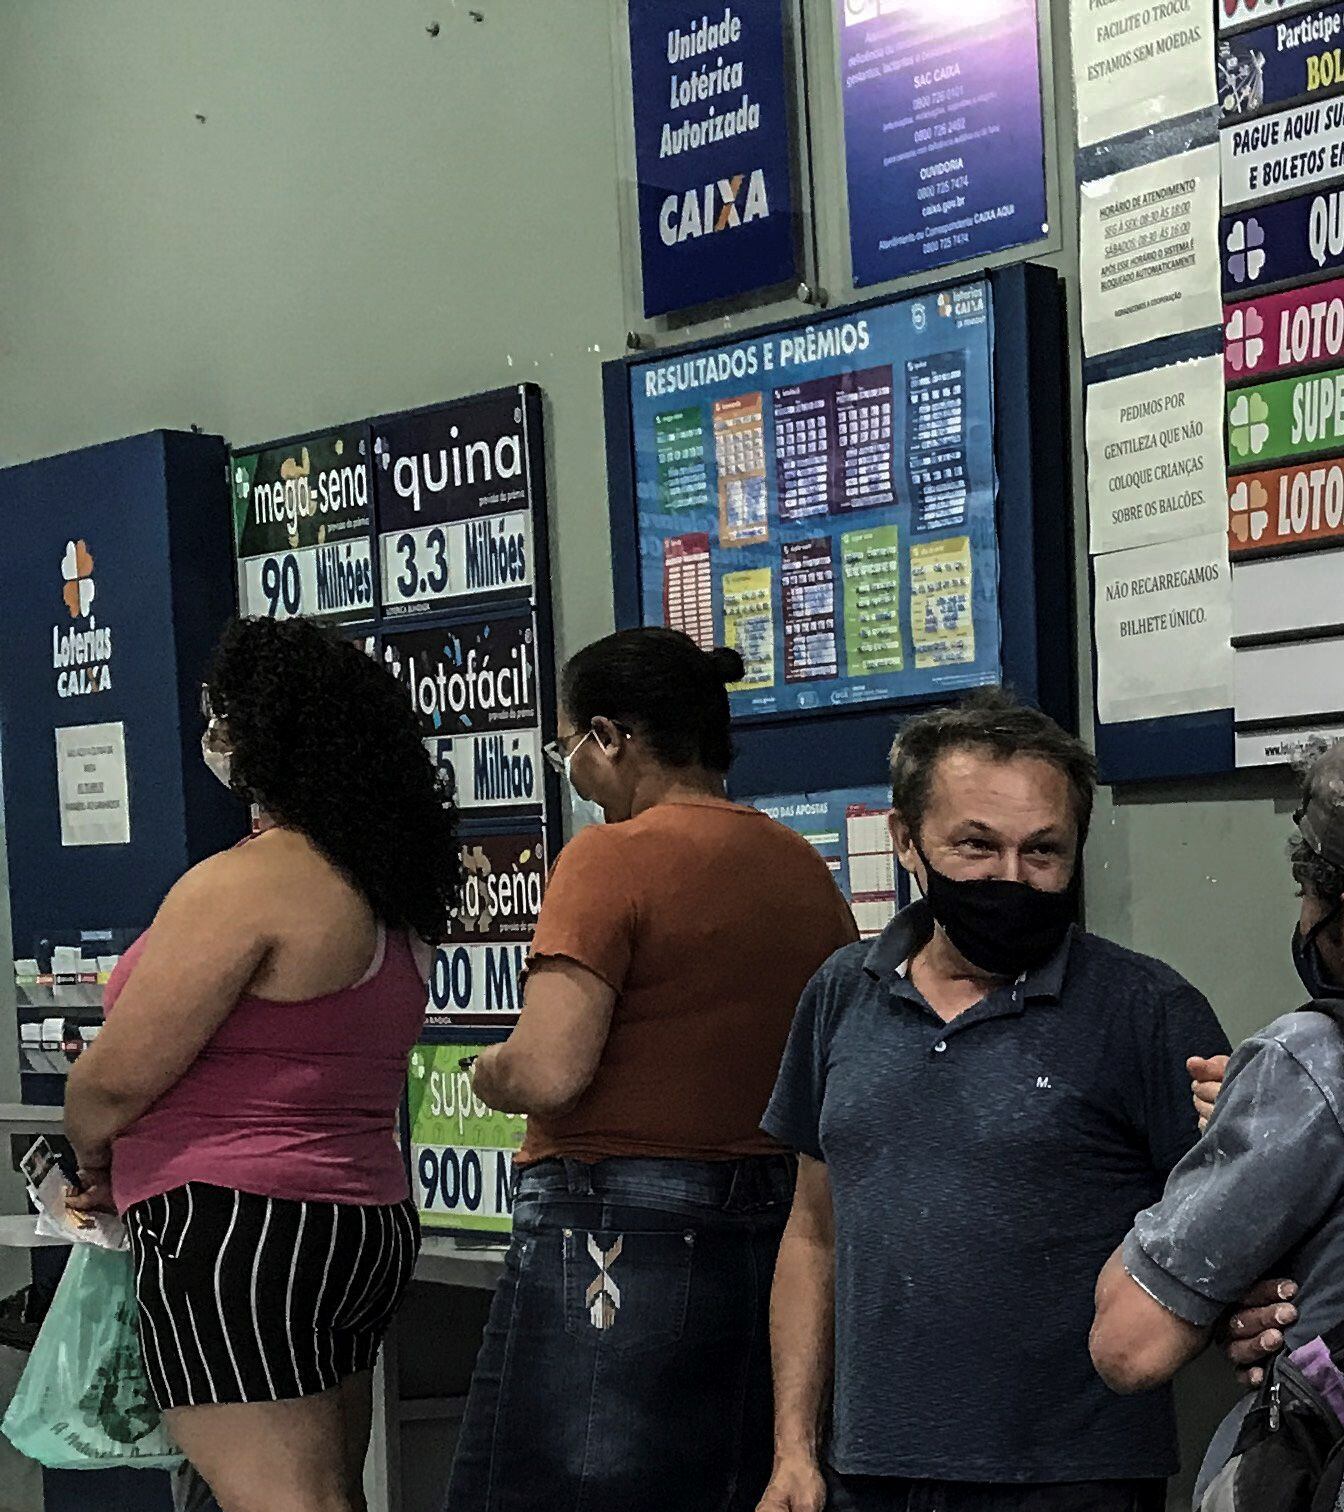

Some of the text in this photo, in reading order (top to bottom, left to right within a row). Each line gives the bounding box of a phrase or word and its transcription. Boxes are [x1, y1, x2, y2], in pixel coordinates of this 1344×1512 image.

[667, 8, 741, 64] Unidade
[1096, 13, 1140, 43] FACILITE
[1142, 10, 1150, 25] O
[1276, 12, 1340, 51] Participe
[670, 56, 744, 109] Lotérica
[913, 63, 961, 89] SAC CAIXA
[1087, 50, 1132, 81] ESTAMOS
[1132, 42, 1154, 63] SEM
[659, 94, 760, 158] Autorizada
[1233, 121, 1280, 156] PAGUE
[1284, 109, 1321, 142] AQUI
[1143, 179, 1196, 205] ATENDIMENTO
[1250, 165, 1258, 190] E
[1263, 147, 1327, 187] BOLETOS
[659, 168, 770, 246] CAIXA
[645, 320, 870, 397] RESULTADOS E PRÊMIOS
[1120, 392, 1185, 423] PEDIMOS POR
[1104, 420, 1204, 460] GENTILEZA QUE NÃO
[393, 426, 522, 512] quina
[1108, 455, 1204, 492] COLOQUE CRIANÇAS
[254, 464, 368, 534] mega-sena
[1112, 503, 1143, 525] SOBRE
[1144, 501, 1158, 517] OS
[262, 554, 300, 617] 90
[397, 527, 448, 598] 3.3
[1106, 564, 1219, 602] NÃO RECARREGAMOS
[53, 615, 112, 668] Loterias
[1120, 614, 1167, 638] BILHETE
[57, 665, 112, 697] CAIXA
[409, 643, 528, 715] lotofácil
[427, 947, 471, 1010] 00
[419, 1148, 482, 1211] 900
